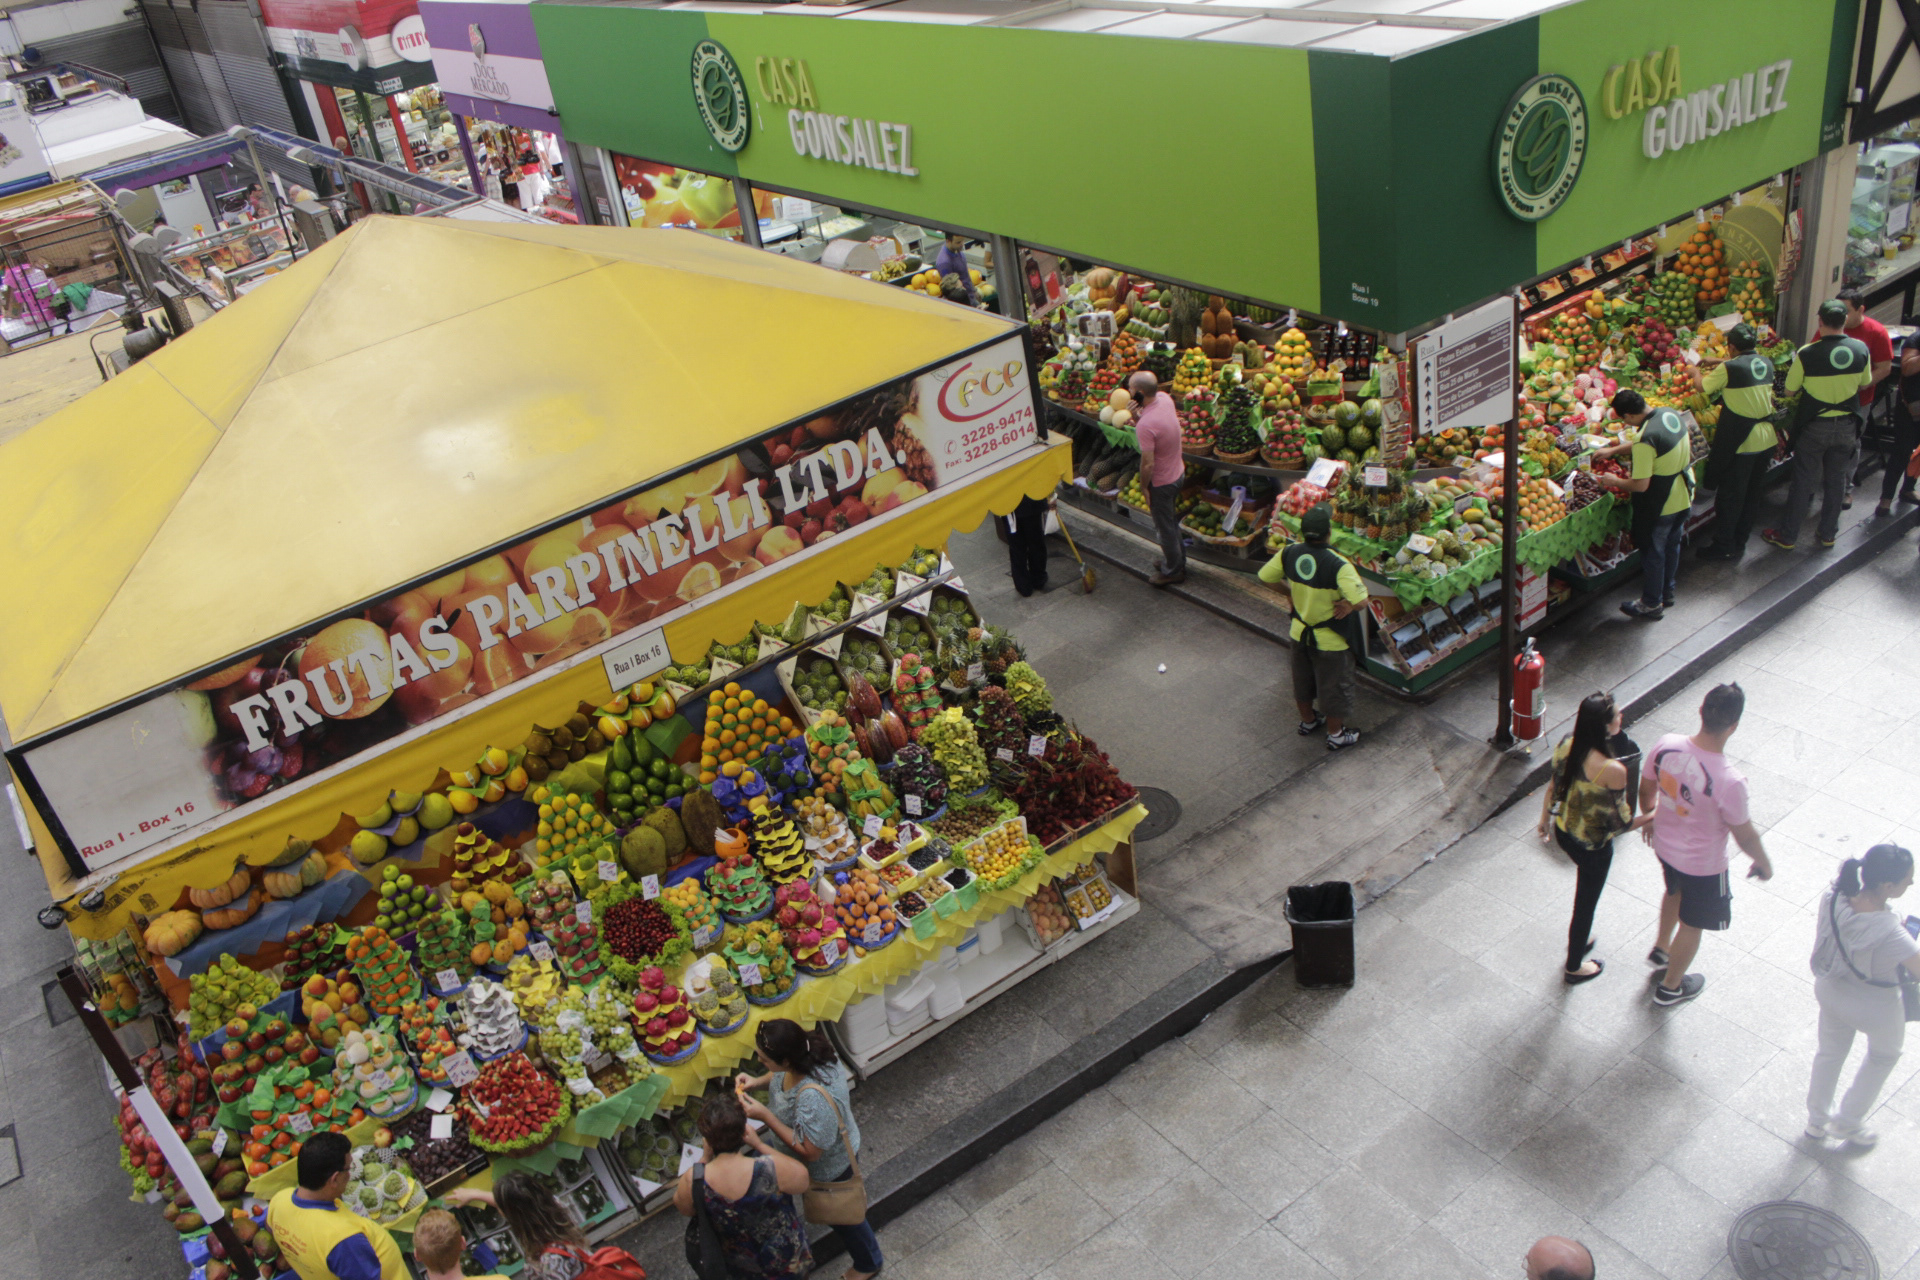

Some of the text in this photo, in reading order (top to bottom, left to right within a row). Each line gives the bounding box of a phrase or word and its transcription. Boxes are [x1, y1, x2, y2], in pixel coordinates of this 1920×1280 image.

[470, 75, 510, 96] MERCADO
[473, 61, 498, 81] DOCE
[755, 55, 819, 108] CASA
[1603, 45, 1682, 120] CASA
[1643, 59, 1792, 159] GONSALEZ
[788, 108, 919, 176] GONSALEZ
[1351, 282, 1366, 294] Rua
[1352, 292, 1379, 307] Boxe 19
[1420, 345, 1435, 358] Rua
[958, 360, 1023, 408] FCP
[945, 422, 1035, 469] Fax: 3228-6014
[961, 406, 1033, 447] 3228-9474
[229, 426, 907, 754] FRUTAS PARPINELLI LTDA.
[613, 662, 630, 675] Rua
[634, 652, 651, 666] Box
[650, 644, 662, 658] 16
[81, 839, 115, 858] Rua
[138, 814, 171, 833] Box
[174, 801, 195, 816] 16
